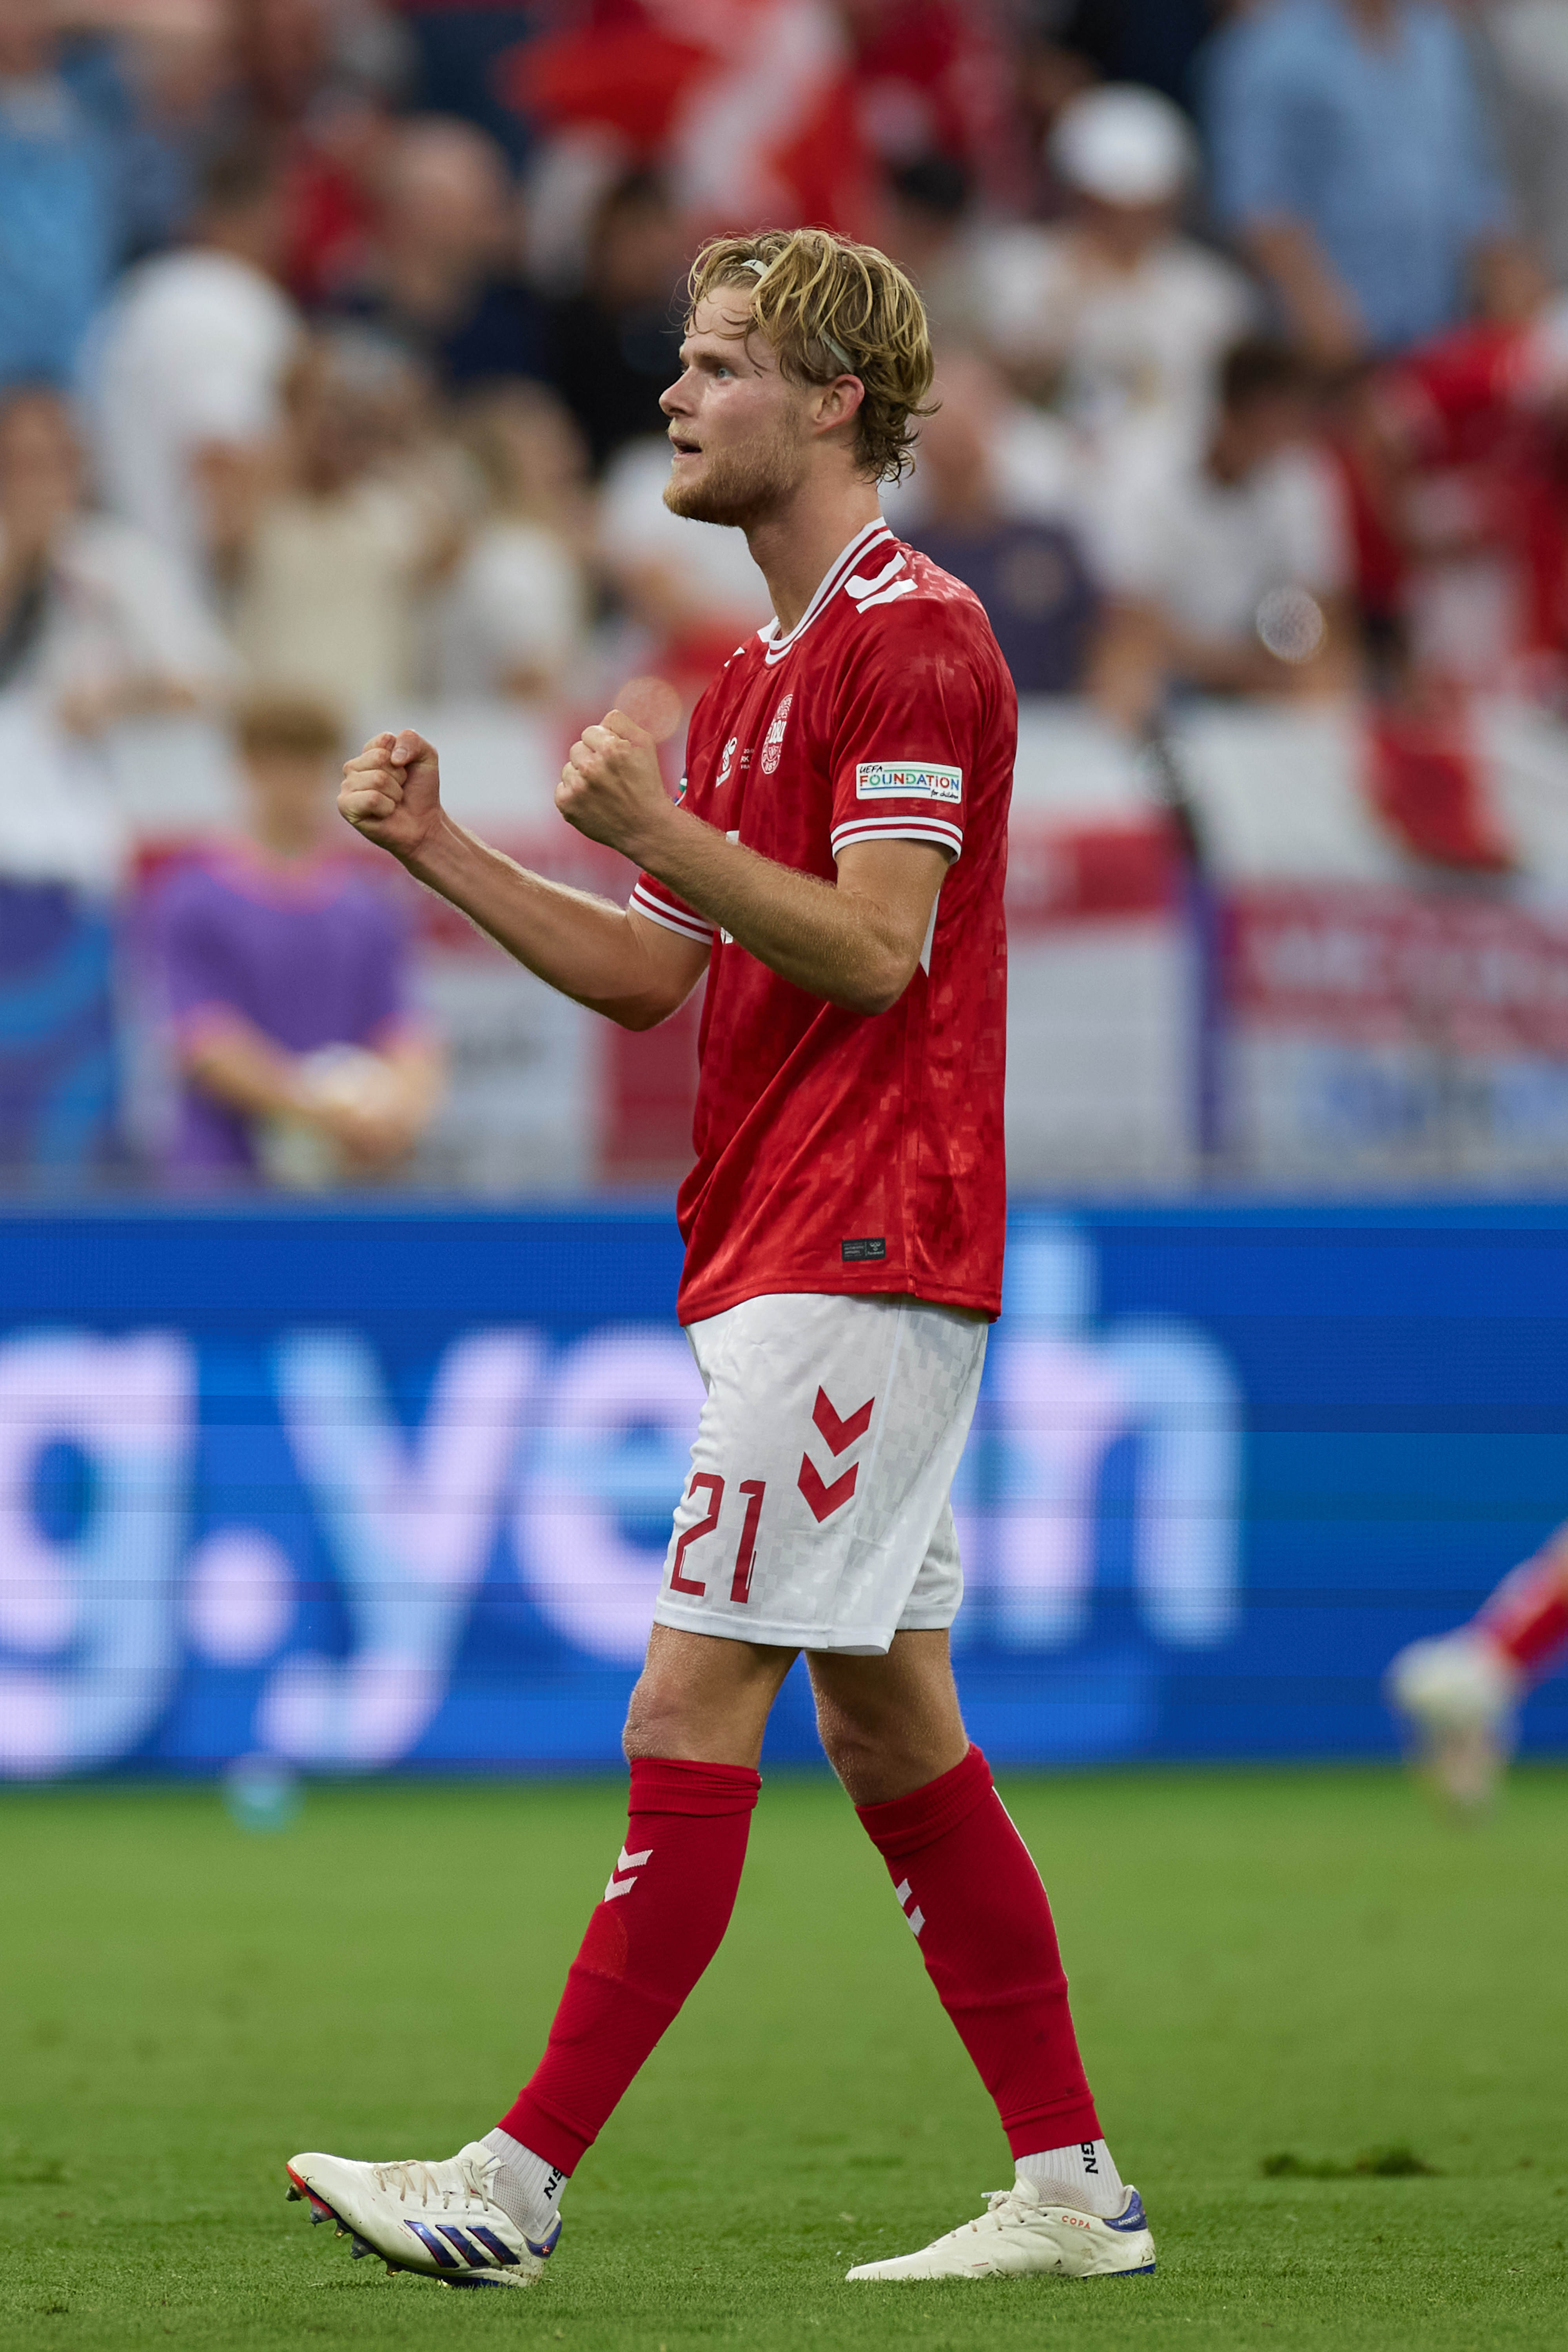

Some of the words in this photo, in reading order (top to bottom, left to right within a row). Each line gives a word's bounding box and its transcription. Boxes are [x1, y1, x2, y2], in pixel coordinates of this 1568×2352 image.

[860, 773, 959, 791] FOUNDATION
[0, 1209, 1243, 1778] g.yeh
[670, 1472, 766, 1603] 21
[1062, 2216, 1090, 2229] COPA
